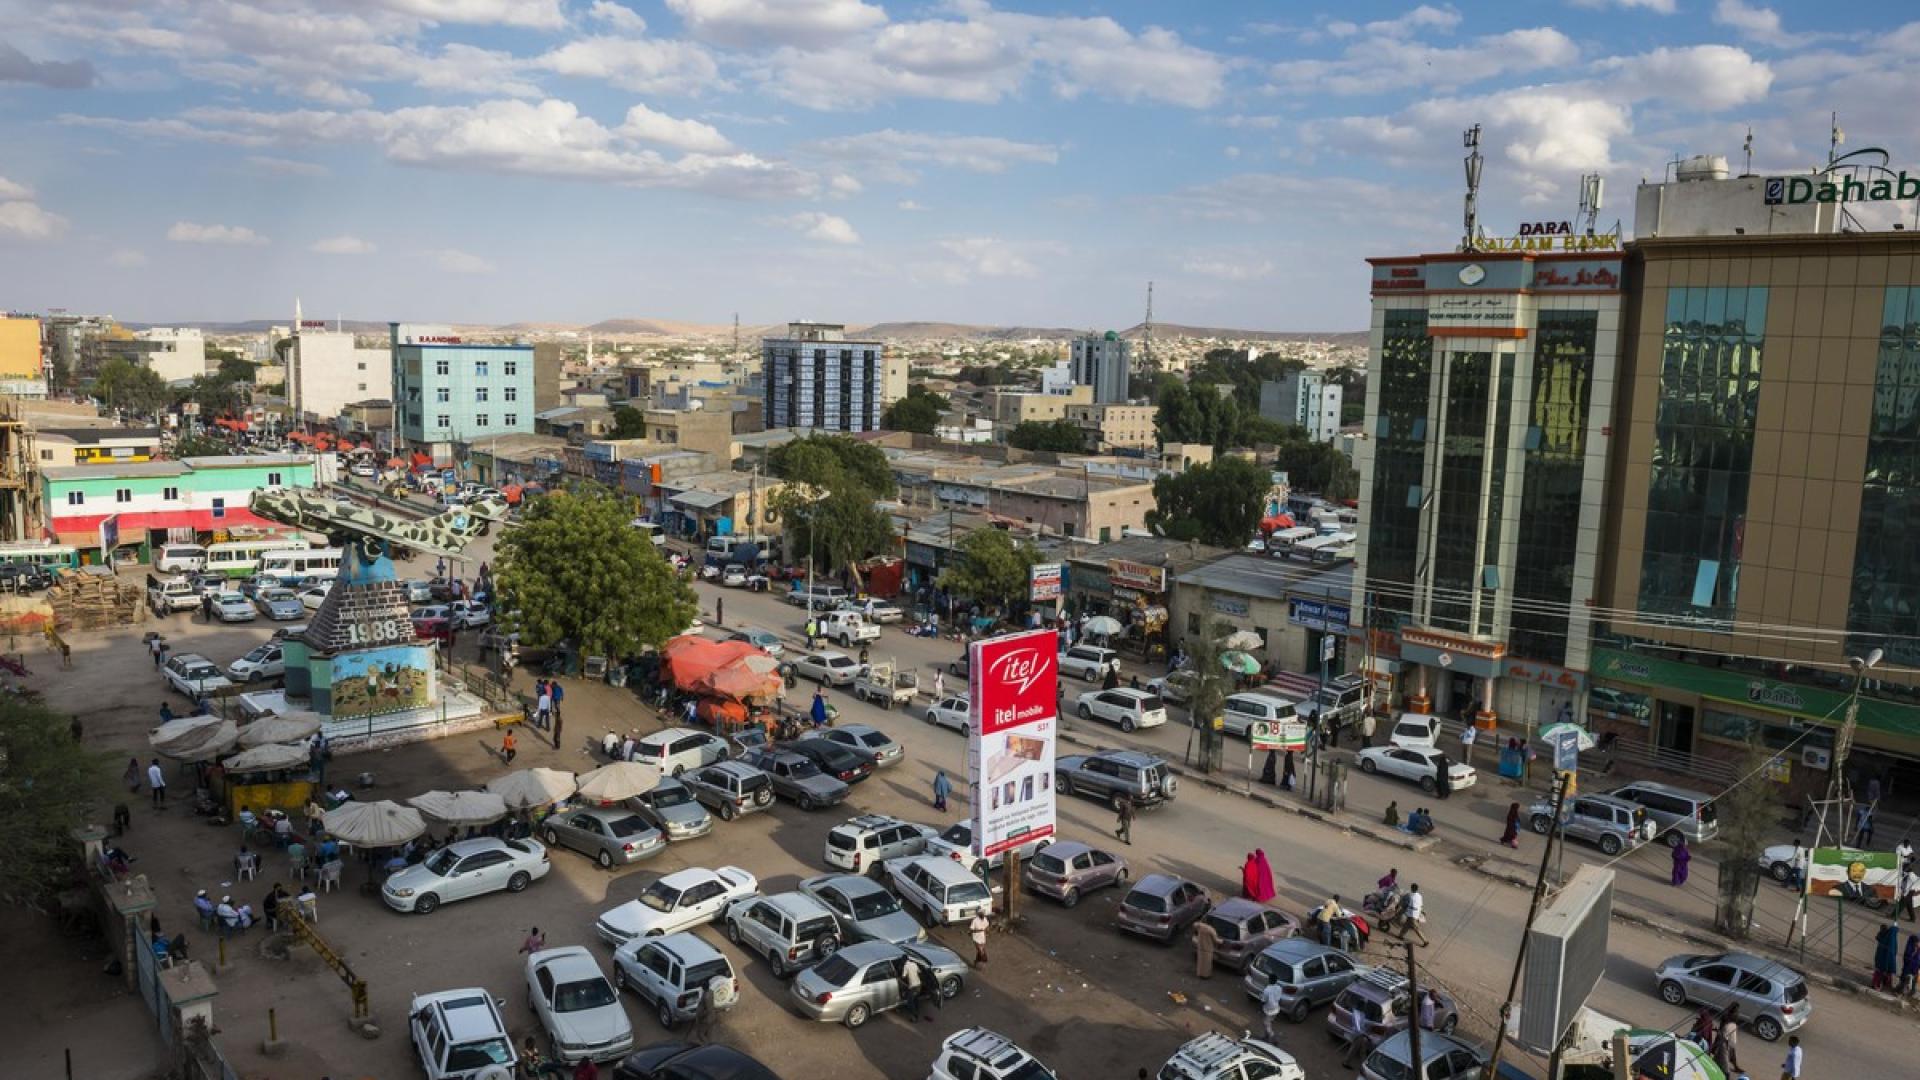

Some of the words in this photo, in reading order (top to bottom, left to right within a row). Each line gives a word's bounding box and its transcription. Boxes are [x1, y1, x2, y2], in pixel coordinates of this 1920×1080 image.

[1520, 221, 1571, 236] DARA
[1475, 236, 1553, 251] SALAAM
[1564, 234, 1618, 250] BANK
[348, 621, 398, 643] 1988
[1003, 650, 1039, 681] itel
[995, 703, 1017, 726] itel
[1017, 705, 1044, 720] mobile
